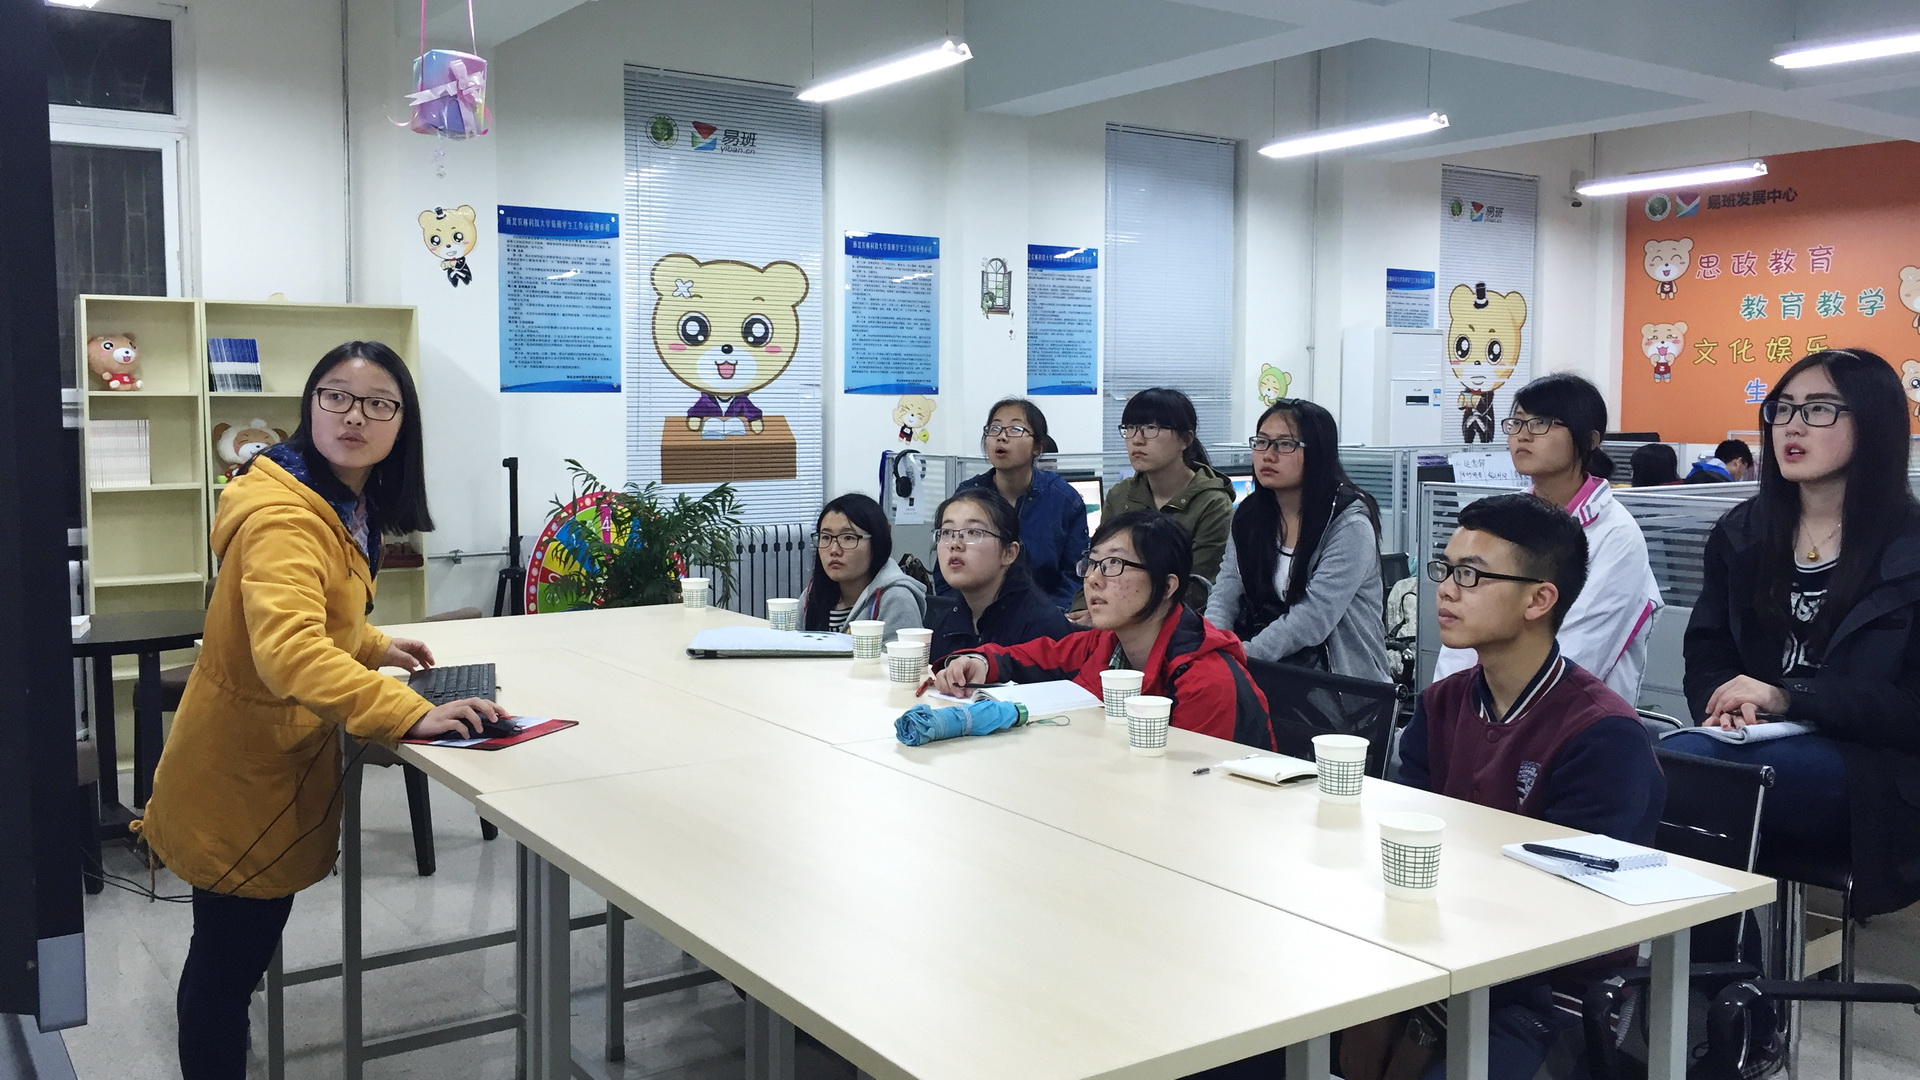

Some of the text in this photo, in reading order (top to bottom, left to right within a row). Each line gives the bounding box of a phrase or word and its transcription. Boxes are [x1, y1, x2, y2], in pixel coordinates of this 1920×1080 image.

[720, 146, 756, 154] yiban.cn
[722, 129, 757, 148] 易班
[1706, 187, 1798, 210] 易班发展中心
[1697, 245, 1833, 279] 思政教育
[1739, 287, 1886, 321] 教育教学
[1693, 335, 1828, 365] 文化娱乐
[602, 516, 611, 532] 4
